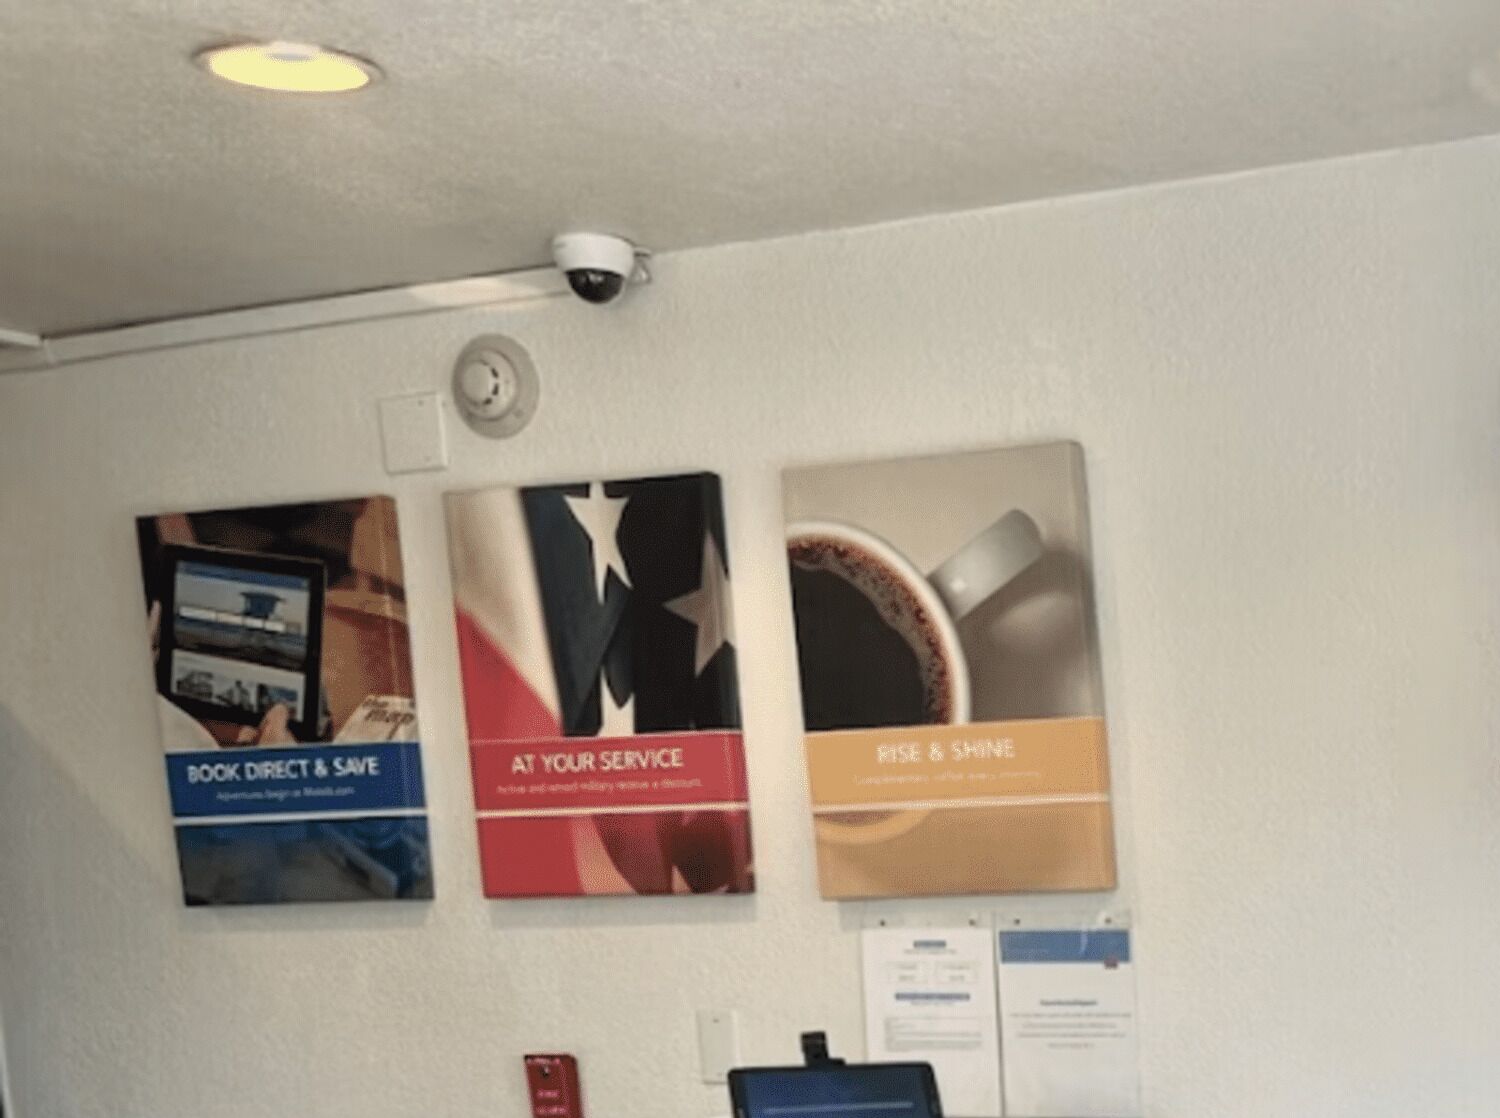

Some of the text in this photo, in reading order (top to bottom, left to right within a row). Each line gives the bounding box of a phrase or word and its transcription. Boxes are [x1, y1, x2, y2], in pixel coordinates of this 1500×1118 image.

[511, 747, 685, 775] AT YOUR SERVICE
[876, 739, 1016, 764] RISE & SHINE
[186, 755, 380, 784] BOOK DIRECT & SAVE
